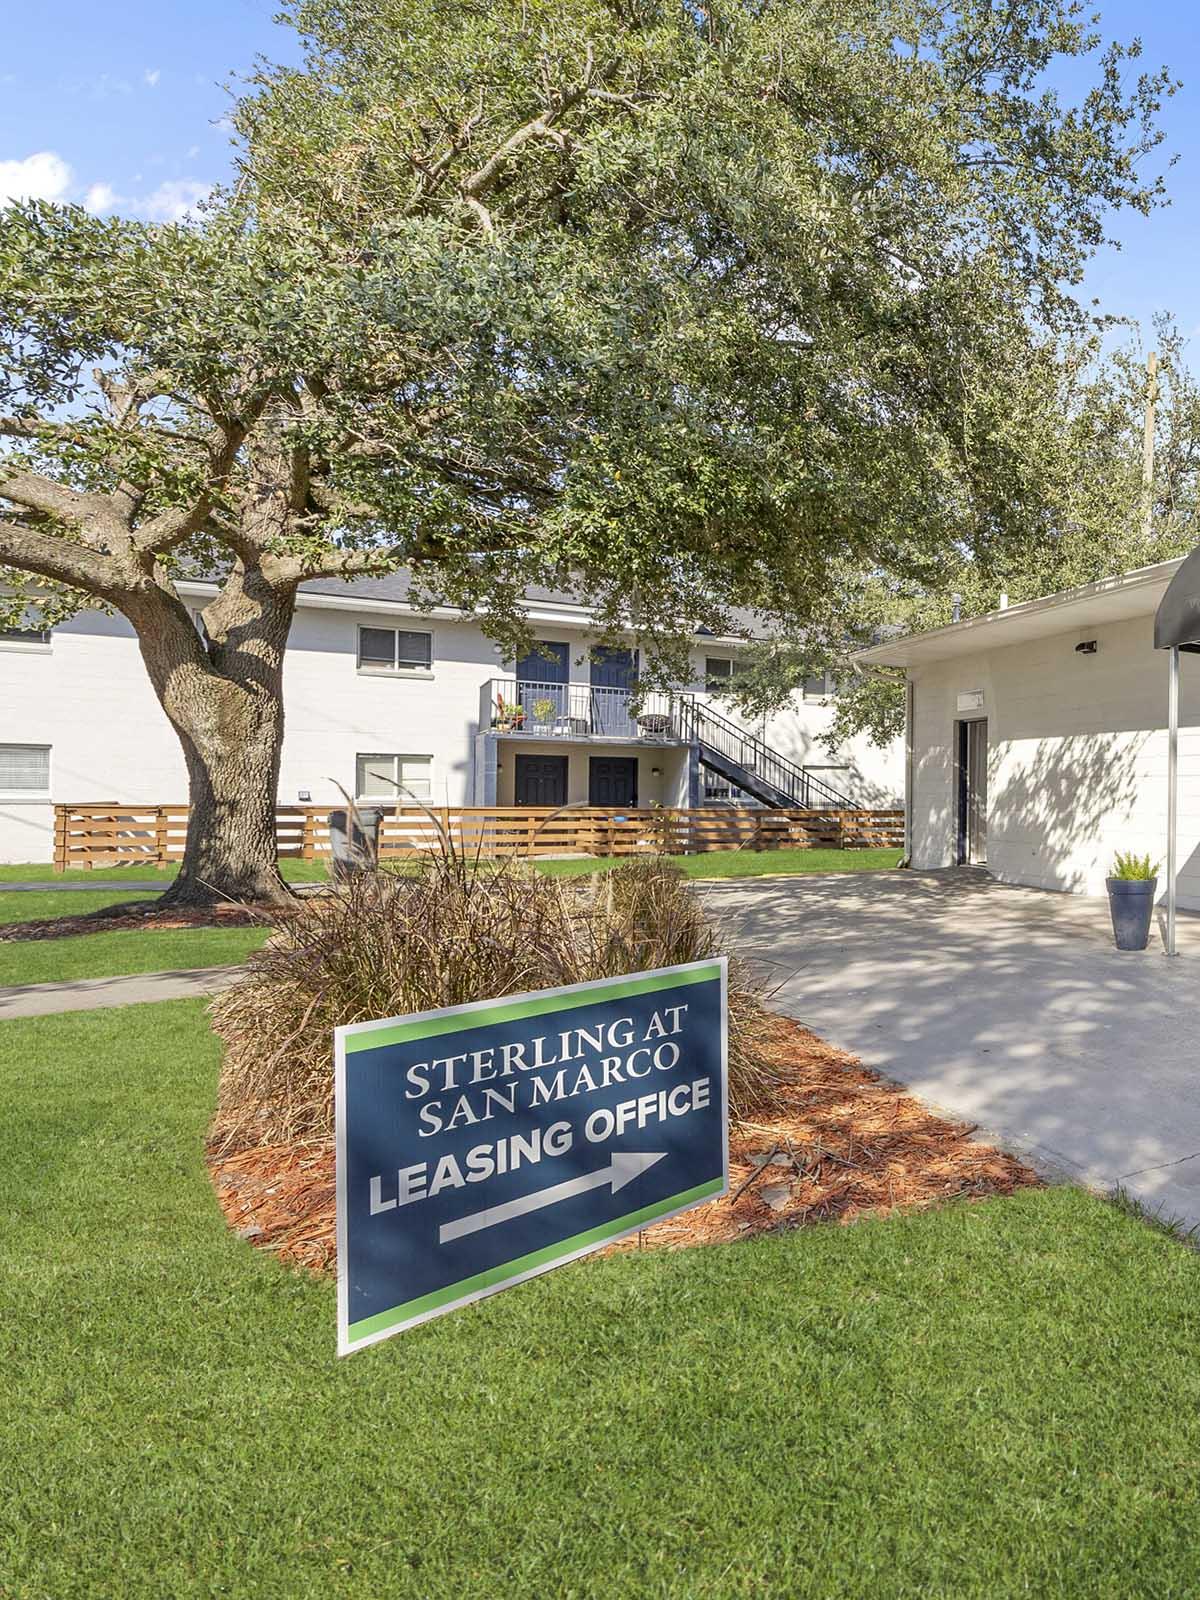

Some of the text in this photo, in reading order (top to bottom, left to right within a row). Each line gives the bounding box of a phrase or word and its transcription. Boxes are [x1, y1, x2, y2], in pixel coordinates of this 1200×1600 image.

[404, 1004, 689, 1100] STERLING AT
[417, 1041, 681, 1138] SAN MARCO
[369, 1076, 712, 1217] LEASING OFFICE
